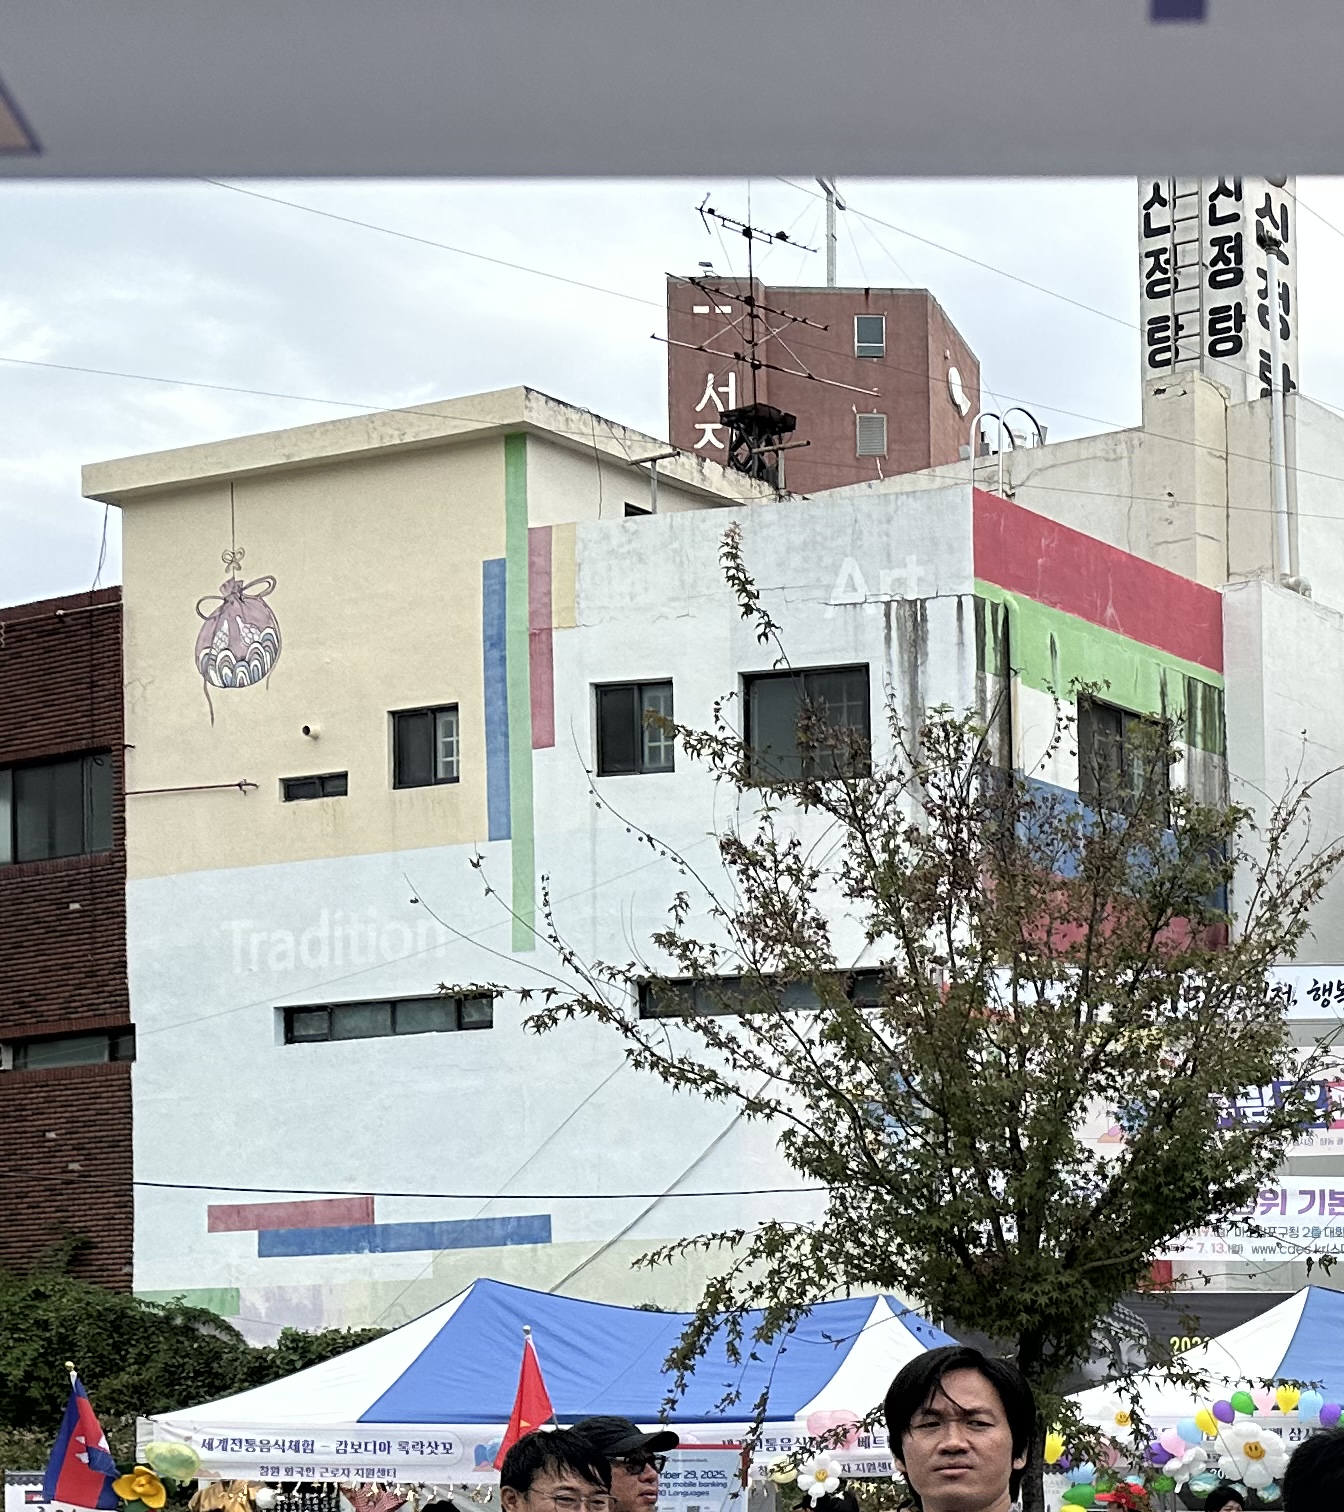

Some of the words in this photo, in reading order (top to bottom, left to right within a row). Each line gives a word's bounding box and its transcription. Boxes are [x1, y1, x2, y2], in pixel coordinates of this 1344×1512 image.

[825, 554, 925, 617] Art
[221, 908, 446, 973] Tradition
[201, 1437, 315, 1454] 세계전통음식체험
[259, 1465, 280, 1477] 창원
[284, 1465, 315, 1478] 외국인
[319, 1466, 351, 1478] 근로자
[354, 1467, 397, 1479] 지원센터
[698, 1481, 728, 1490] banking
[668, 1489, 710, 1498] Languages
